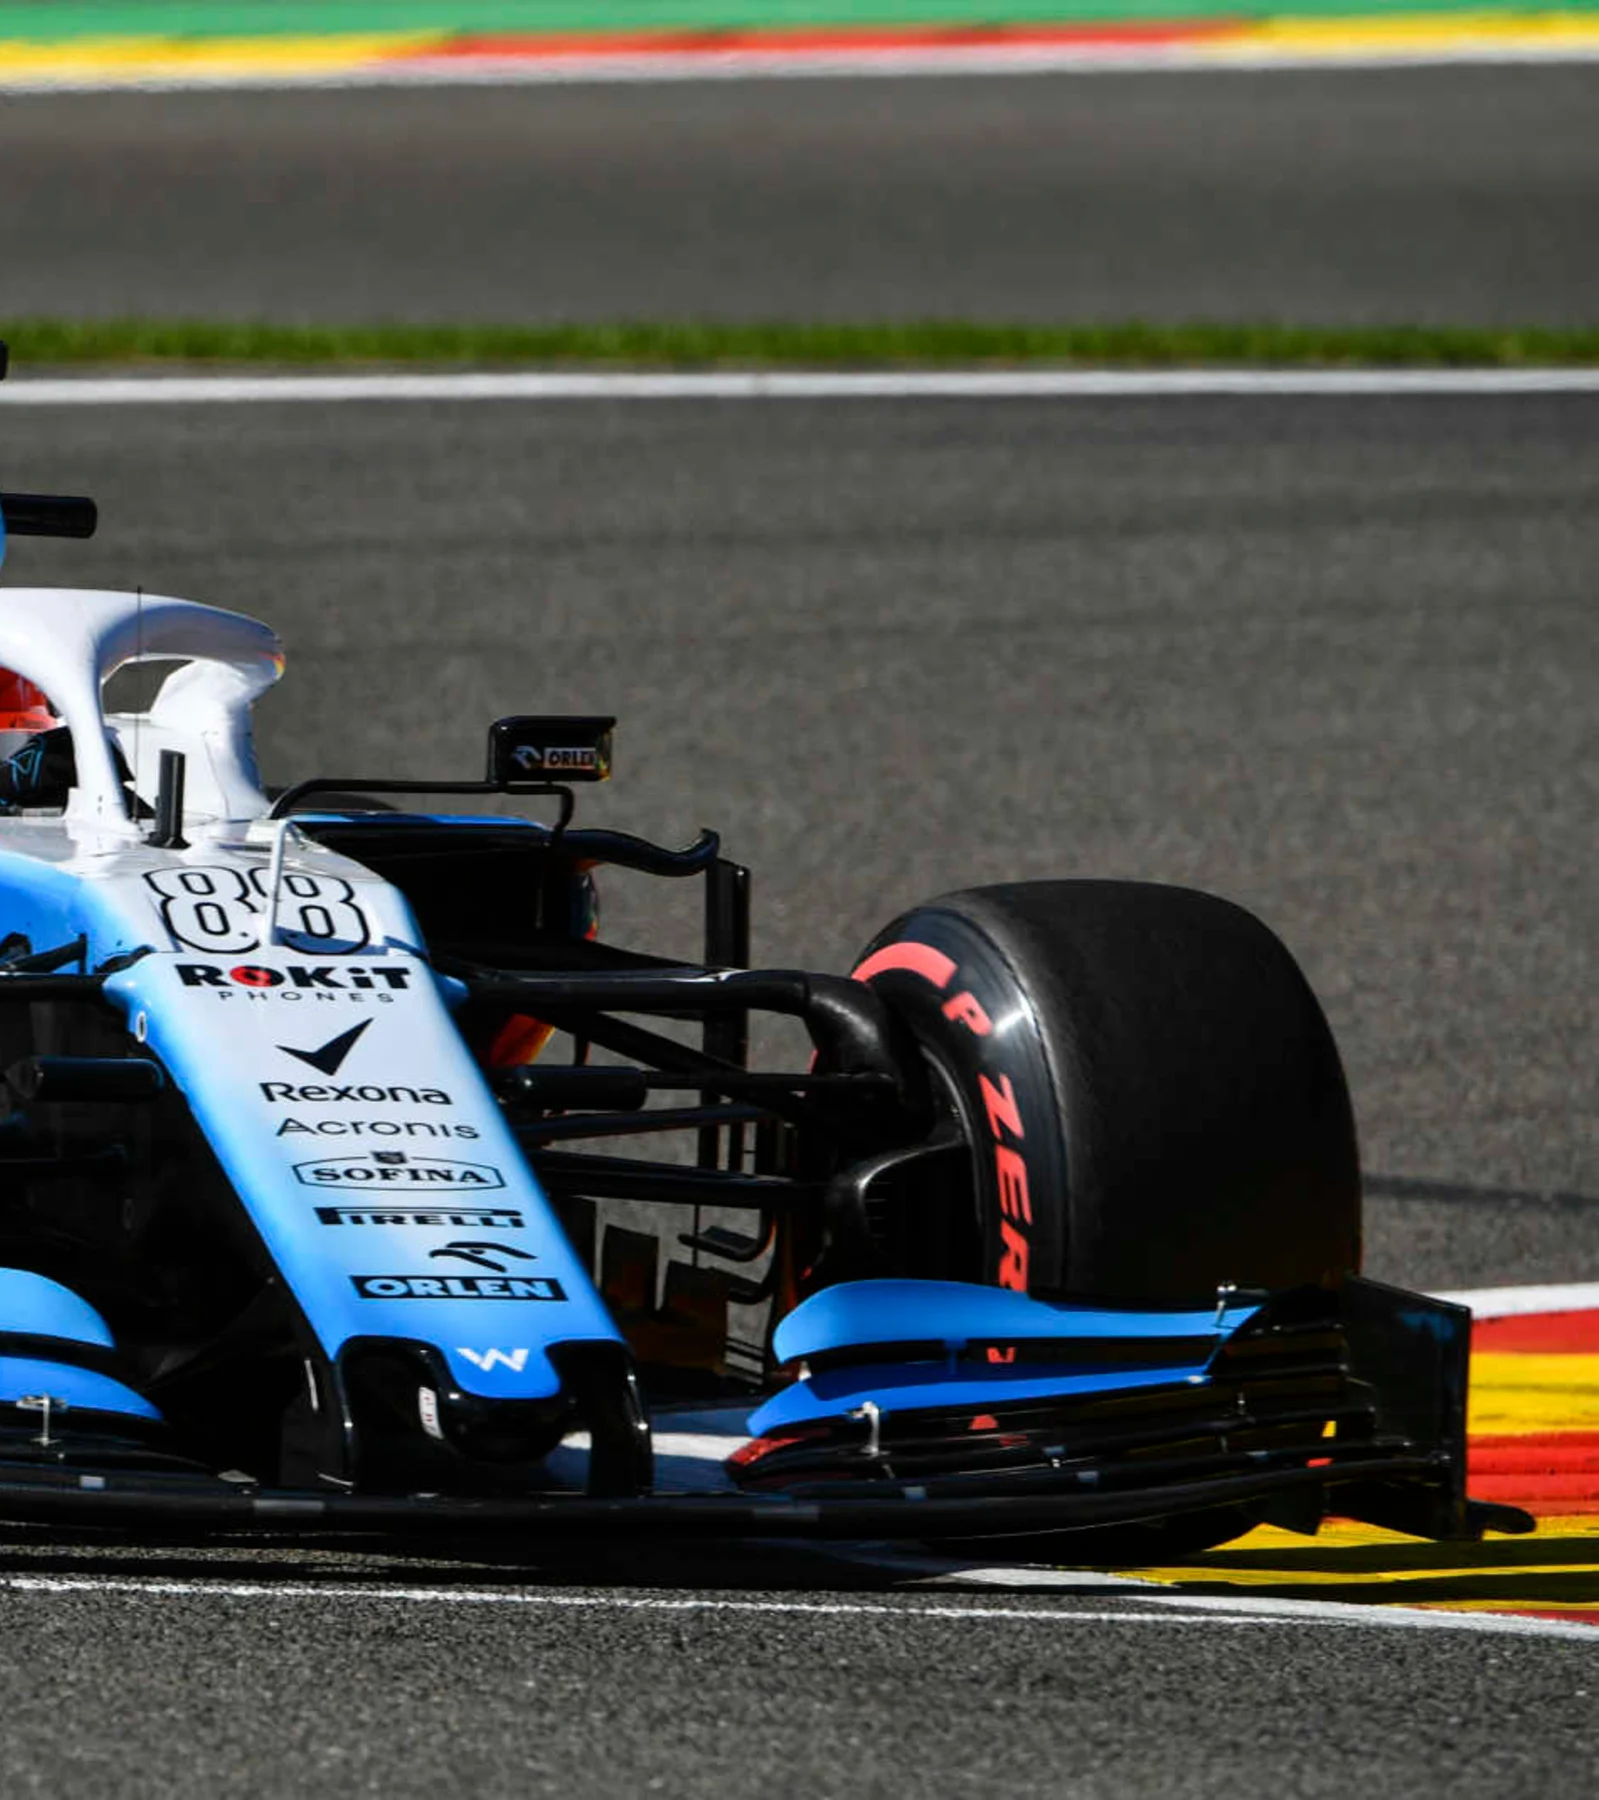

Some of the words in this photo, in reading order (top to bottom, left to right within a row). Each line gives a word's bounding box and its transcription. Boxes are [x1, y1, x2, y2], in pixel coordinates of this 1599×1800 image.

[142, 866, 371, 955] 88
[174, 964, 411, 989] ROKiT
[218, 991, 395, 1003] PHONES
[259, 1082, 453, 1105] Rexona
[275, 1117, 481, 1139] Acronis
[941, 991, 994, 1037] P
[978, 1072, 1033, 1293] ZER
[312, 1167, 489, 1183] SOFINA
[313, 1207, 526, 1228] PIRELLI
[362, 1278, 555, 1298] ORLEN
